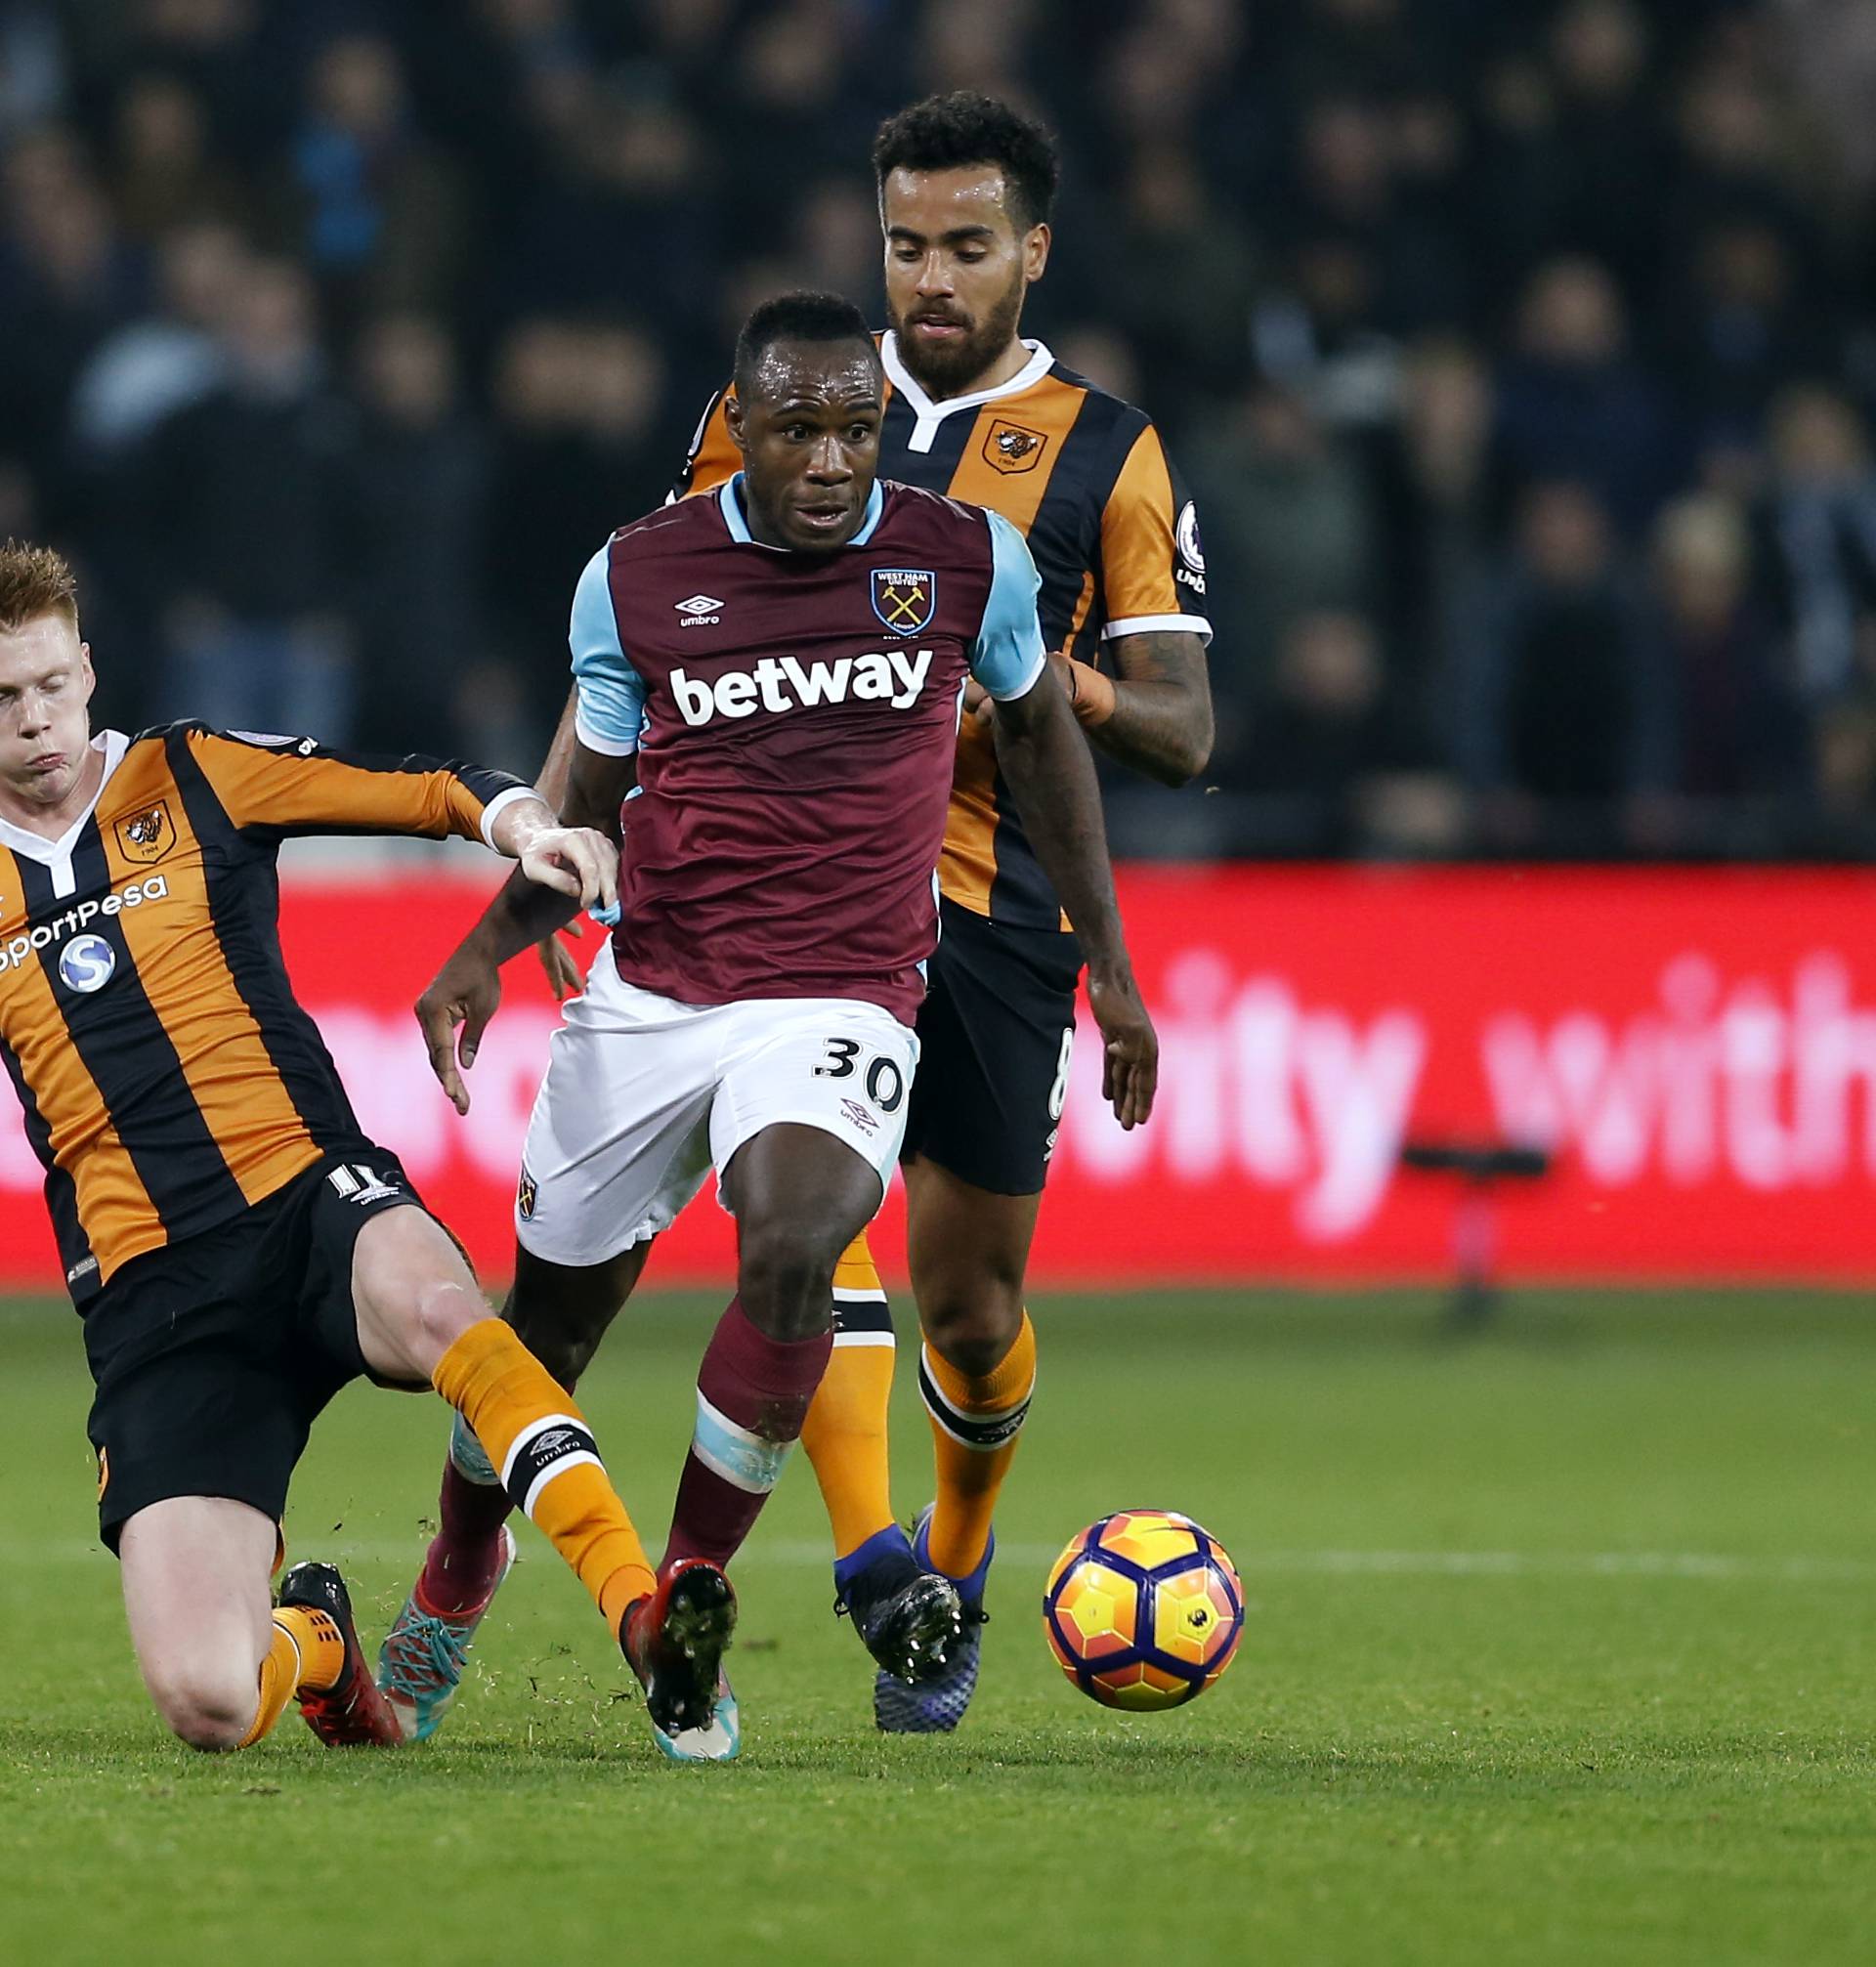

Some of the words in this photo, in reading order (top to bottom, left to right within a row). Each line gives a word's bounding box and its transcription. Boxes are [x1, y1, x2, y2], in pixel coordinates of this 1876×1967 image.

[906, 574, 928, 582] HAM
[680, 615, 720, 627] umbro
[669, 650, 933, 727] betway
[812, 1038, 905, 1114] 30
[535, 1440, 581, 1467] umbro
